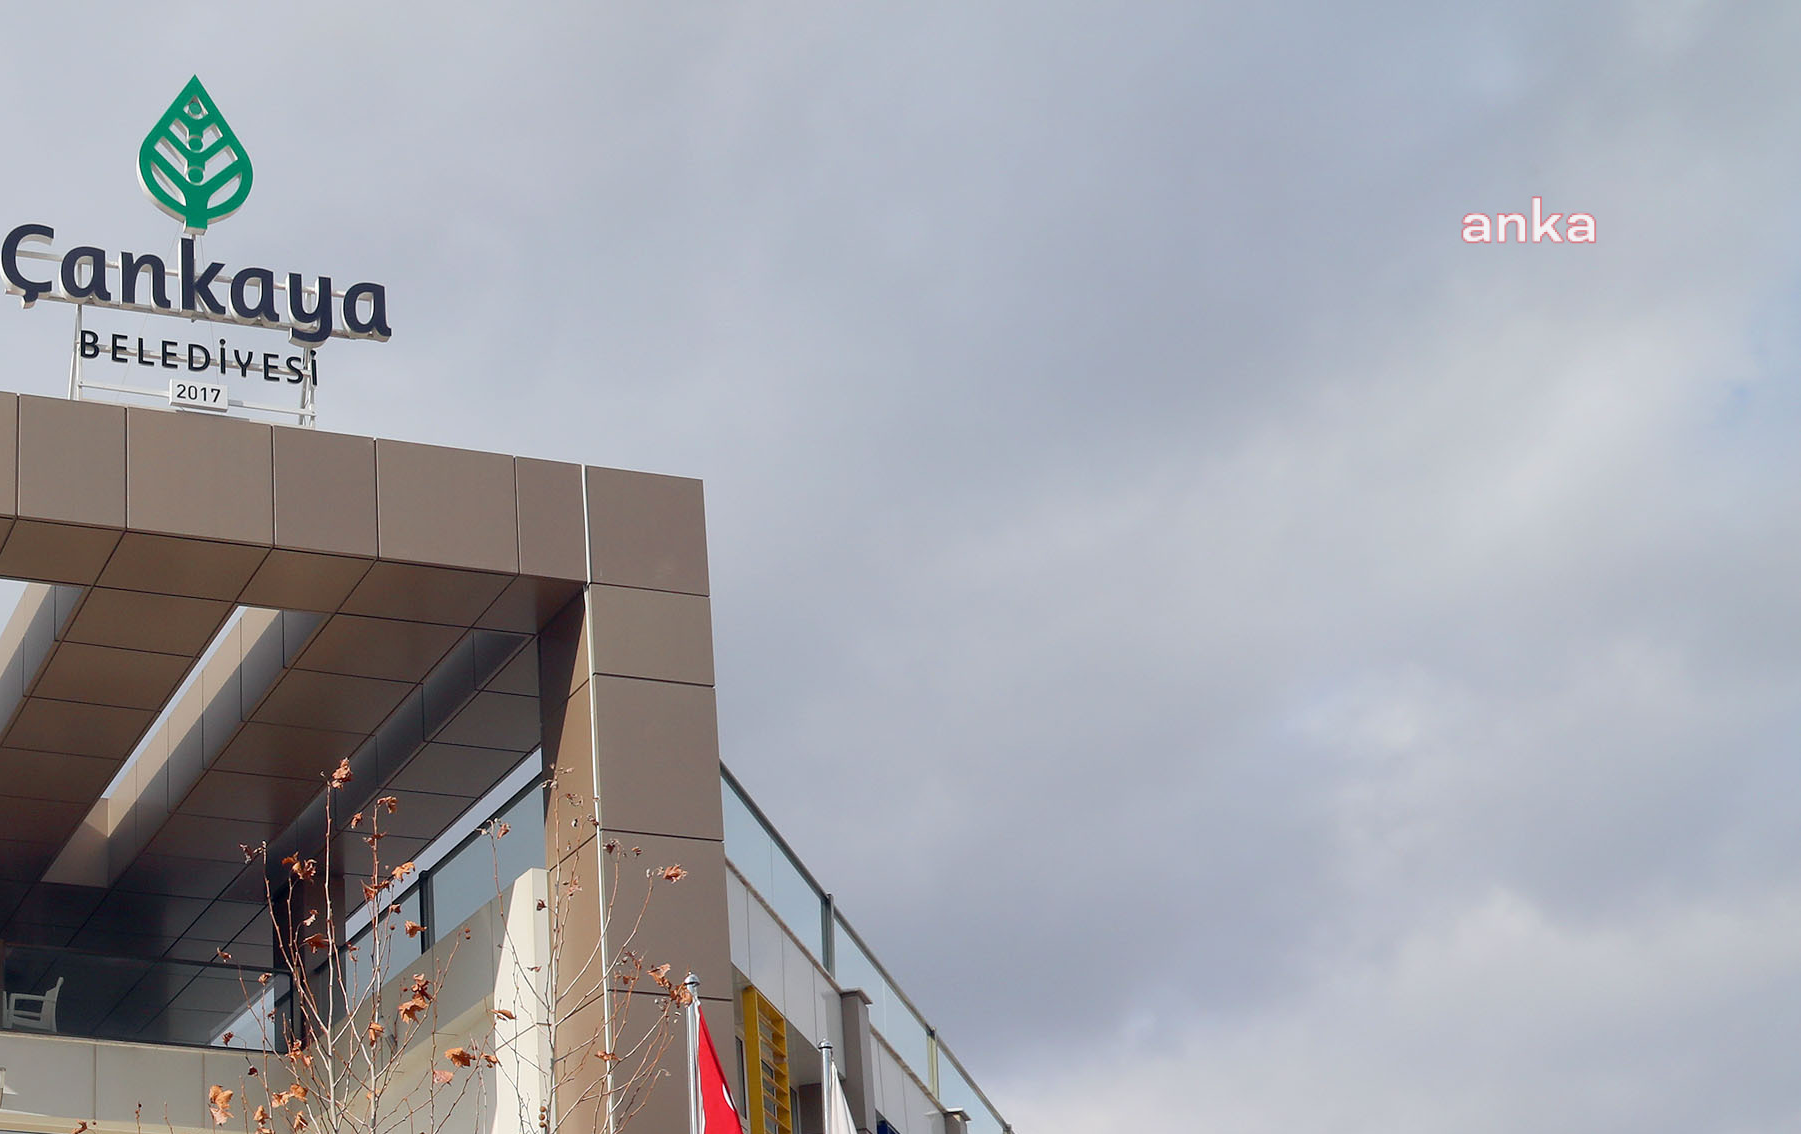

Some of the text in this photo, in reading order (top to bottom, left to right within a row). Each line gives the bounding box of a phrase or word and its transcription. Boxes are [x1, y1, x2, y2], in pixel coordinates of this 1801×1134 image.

[0, 223, 392, 347] Çankaya
[79, 329, 318, 386] BELEDİYESİ
[176, 383, 221, 404] 2017
